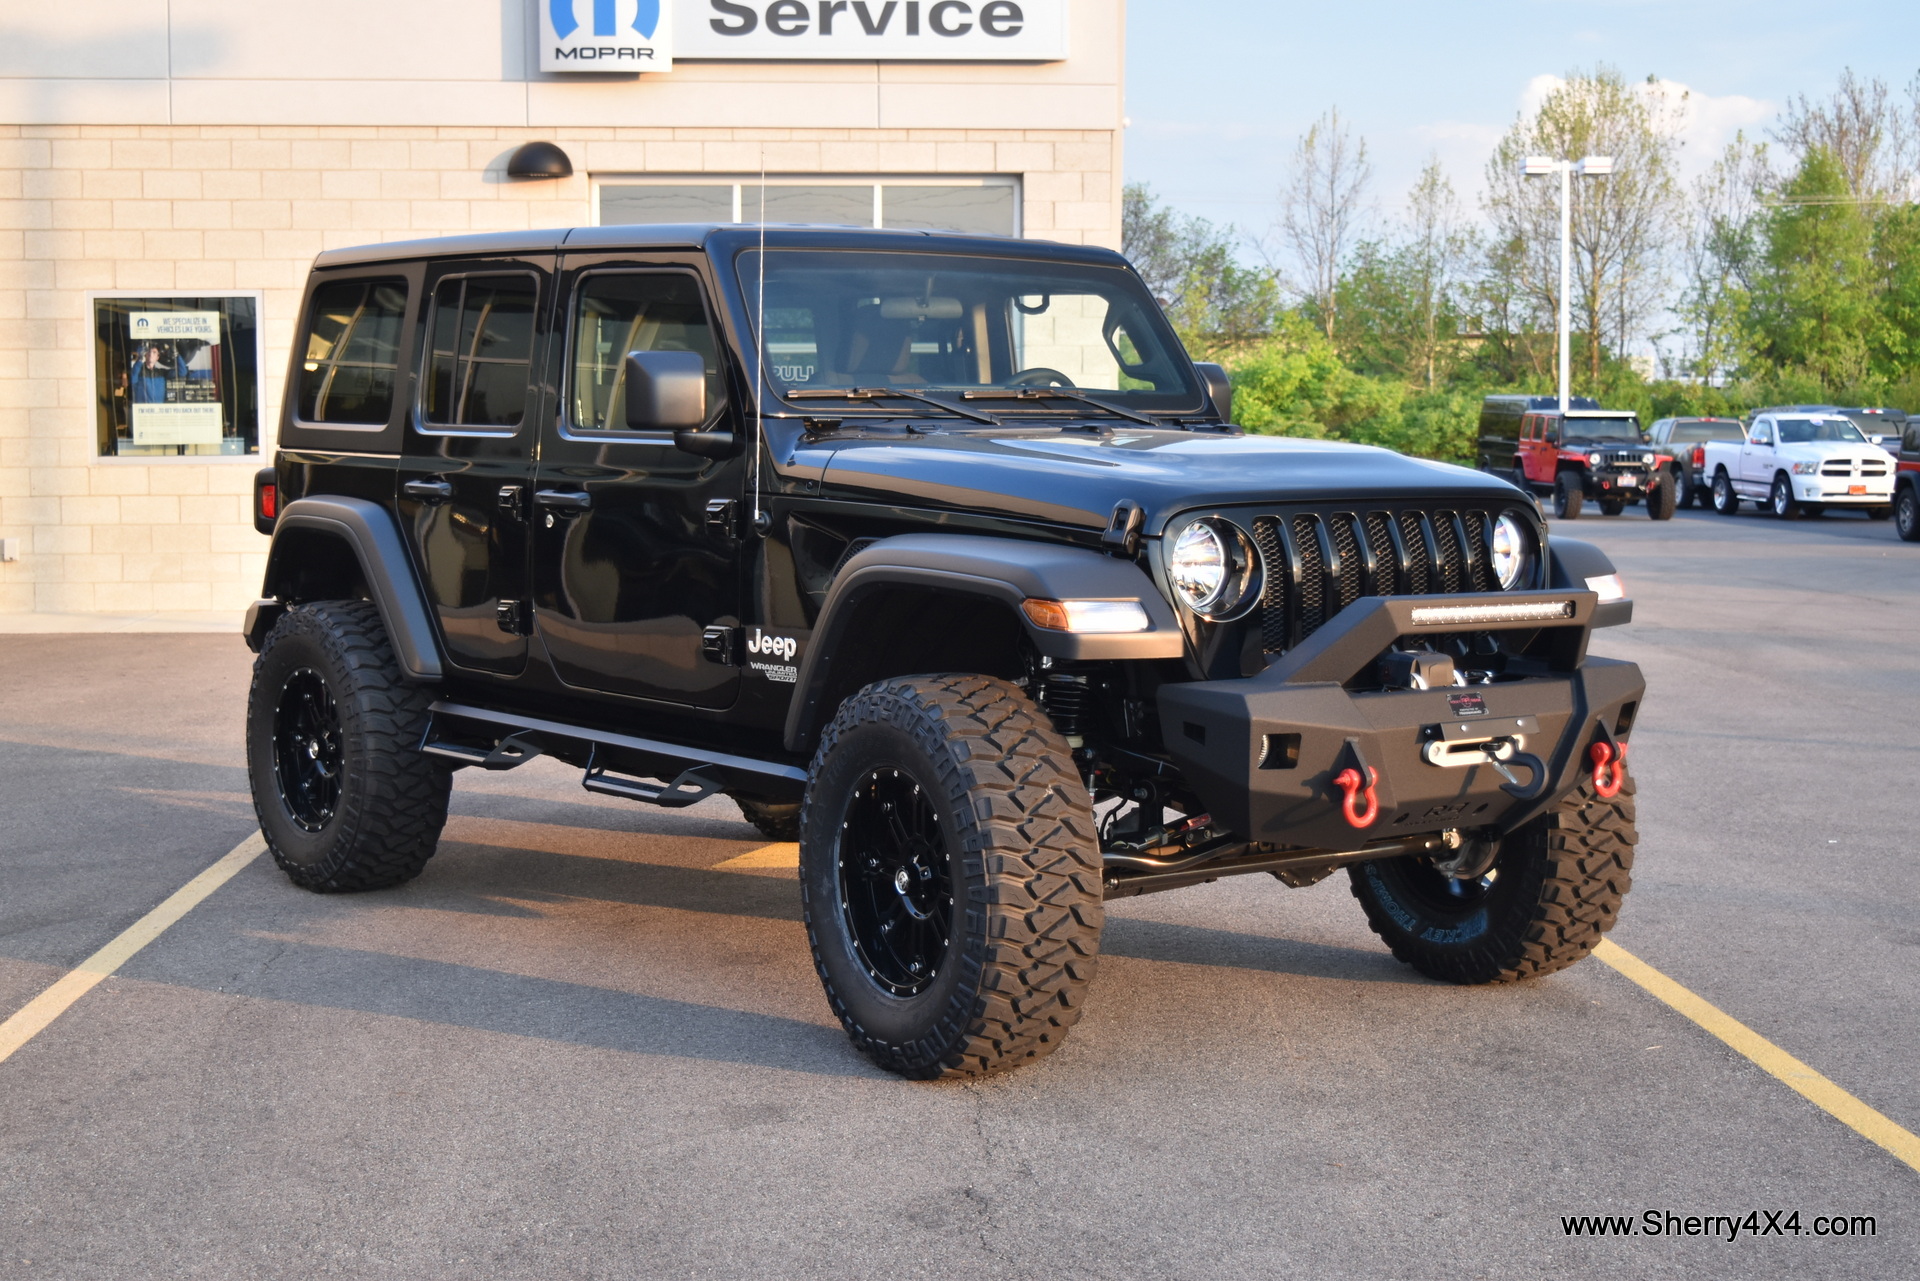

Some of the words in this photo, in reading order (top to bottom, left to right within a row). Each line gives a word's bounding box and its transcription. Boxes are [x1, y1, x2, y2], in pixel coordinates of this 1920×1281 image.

[709, 0, 1024, 37] Service
[555, 47, 655, 60] MOPAR
[157, 325, 181, 333] VEHICLES
[182, 325, 193, 333] LIKE
[163, 317, 171, 325] WE
[172, 317, 200, 325] SPECIALIZE
[202, 317, 208, 325] IN
[748, 628, 797, 662] Jeep
[750, 661, 797, 673] WRANGLER
[1363, 859, 1418, 932] THOMPS
[1420, 909, 1488, 943] MICKEY
